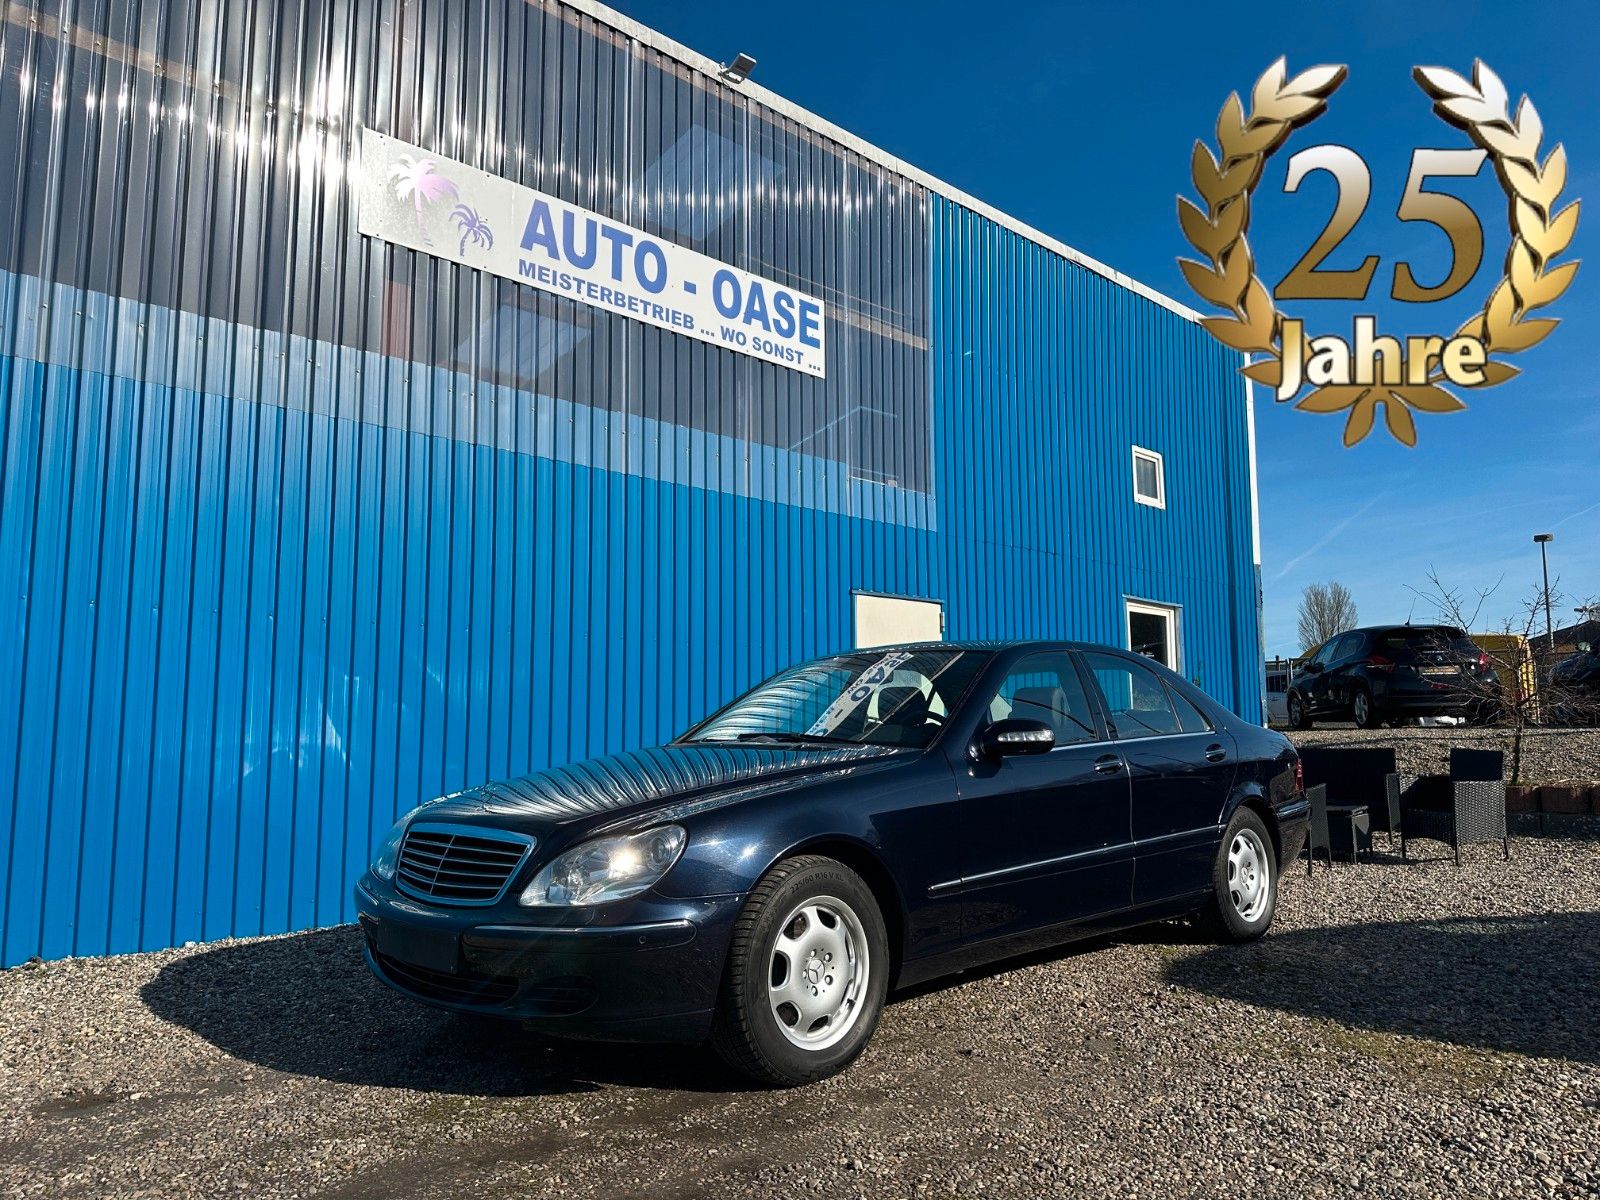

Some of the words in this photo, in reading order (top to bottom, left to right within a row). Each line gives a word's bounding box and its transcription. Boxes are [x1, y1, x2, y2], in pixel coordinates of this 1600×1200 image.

[518, 258, 695, 331] MEISTERBETRIEB
[700, 328, 715, 337] ...
[720, 325, 747, 346] WO
[752, 336, 804, 365] SONST
[520, 199, 667, 294] AUTO
[684, 280, 697, 295] -
[712, 269, 821, 350] OASE
[790, 874, 814, 894] 225/60
[815, 872, 828, 880] R16
